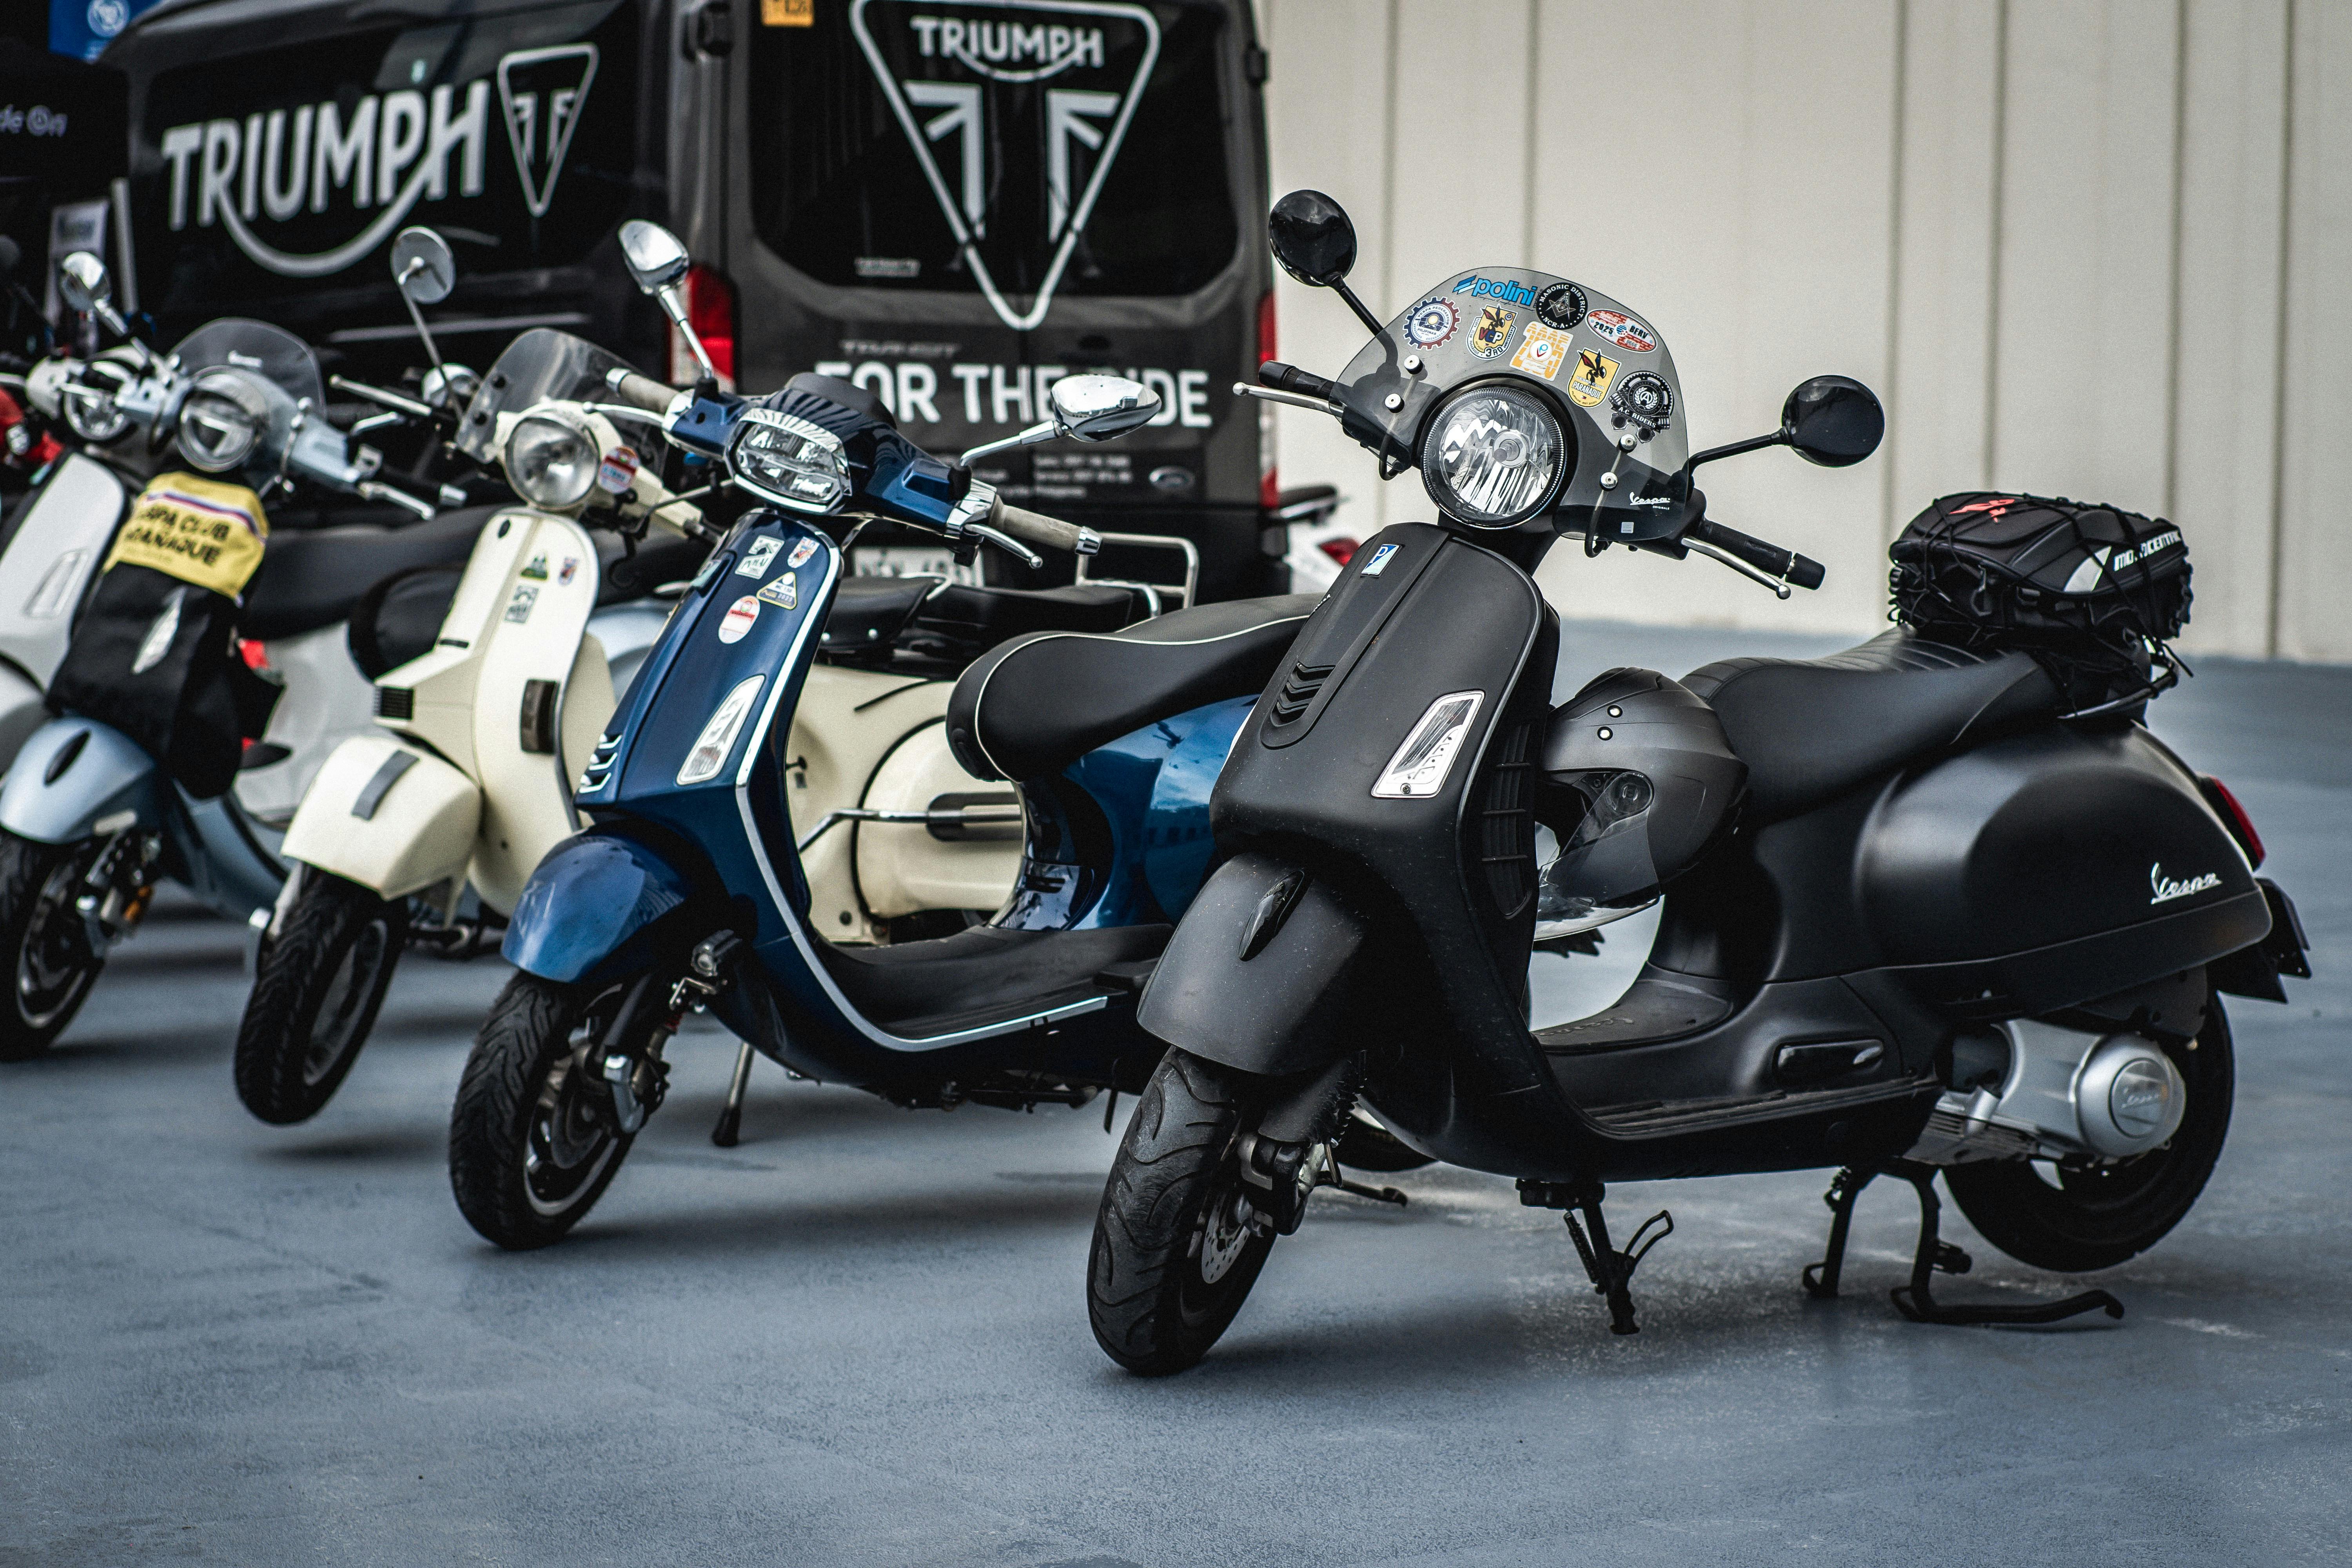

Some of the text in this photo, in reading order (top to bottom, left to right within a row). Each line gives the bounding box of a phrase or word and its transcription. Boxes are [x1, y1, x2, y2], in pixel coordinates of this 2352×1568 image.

[909, 14, 1105, 83] TRIUMPH
[161, 80, 491, 278] TRIUMPH
[1471, 278, 1538, 307] polini
[1539, 284, 1586, 318] MASONIC DISTRICT
[1417, 307, 1431, 317] VESPA
[1543, 317, 1565, 328] NCR-A
[1593, 321, 1614, 335] 2025
[1478, 327, 1504, 344] VCP
[1503, 327, 1514, 348] ANNIVERSARY
[1572, 380, 1603, 399] PARAÑAQUE
[1576, 376, 1592, 385] VESPA
[815, 360, 941, 423] OR
[951, 363, 1067, 423] THE
[1632, 412, 1657, 428] RIDERS
[1629, 492, 1670, 506] Vespa
[2151, 862, 2223, 904] Vespa
